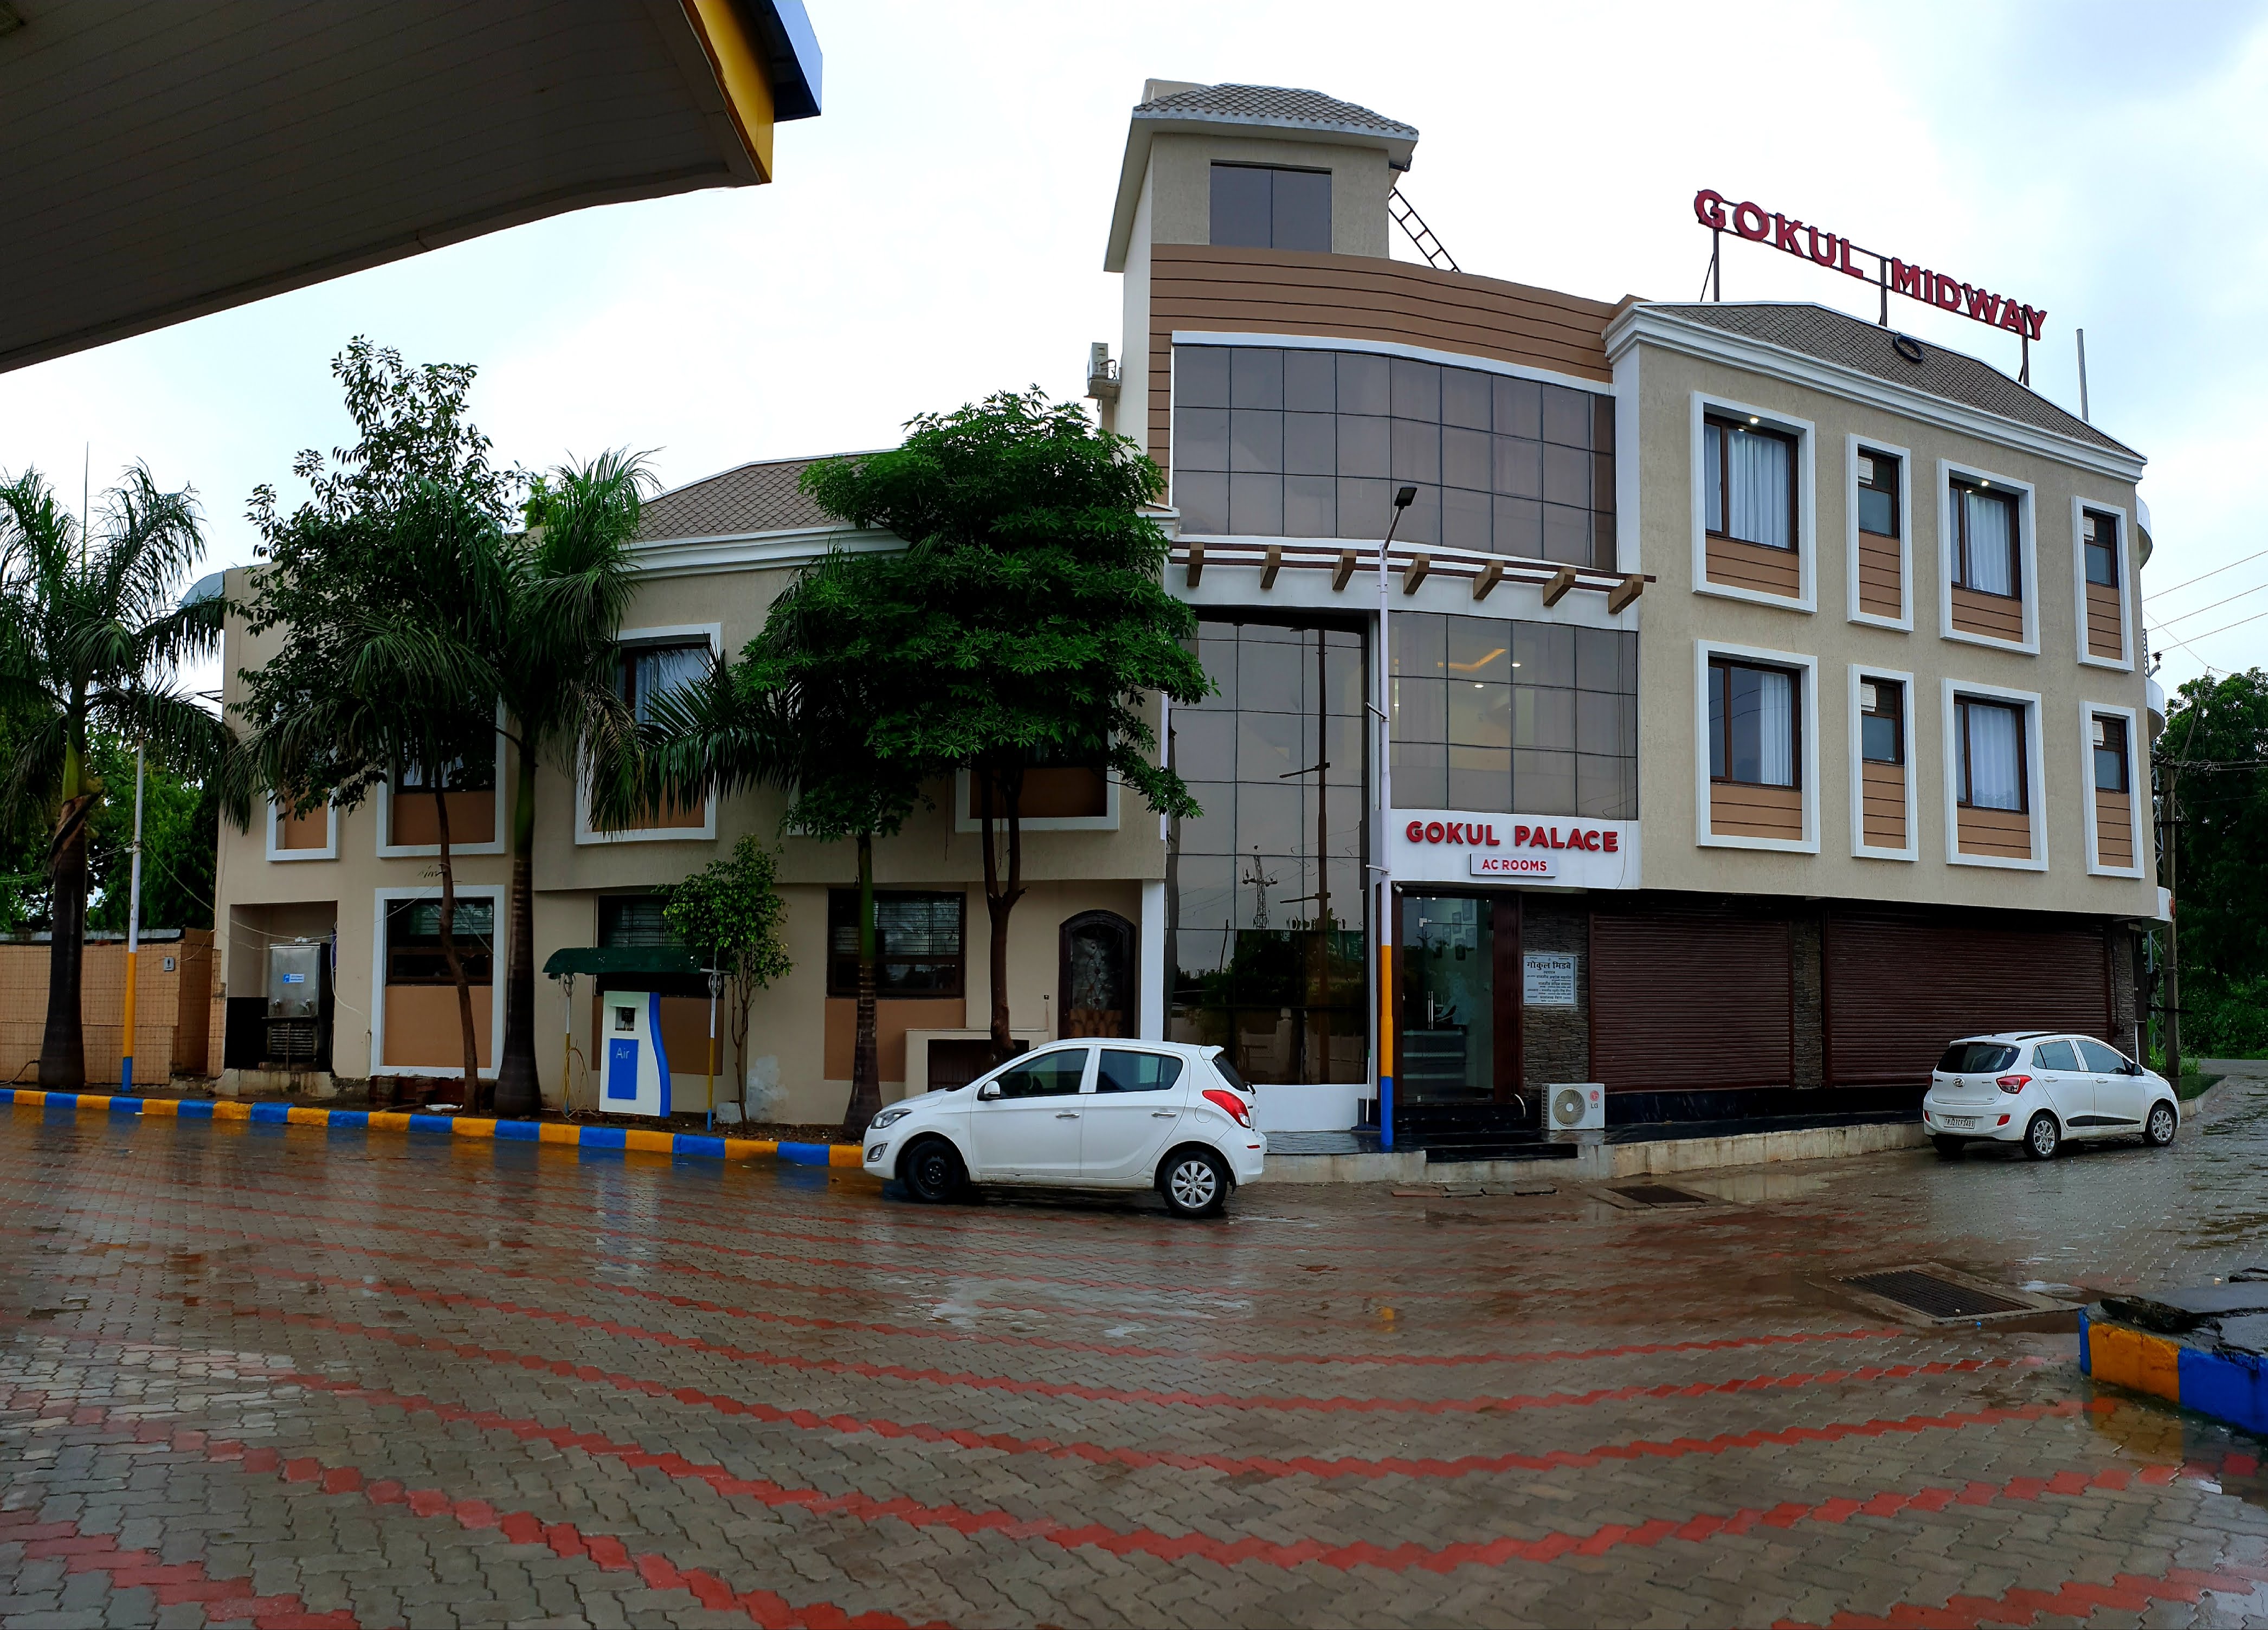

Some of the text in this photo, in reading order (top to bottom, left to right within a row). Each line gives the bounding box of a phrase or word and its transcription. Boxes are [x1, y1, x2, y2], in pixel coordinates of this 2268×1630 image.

[1694, 189, 2047, 342] GOKUL MIDWAY
[1406, 821, 1619, 852] GOKUL PALACE
[1482, 859, 1547, 872] AC ROOMS
[1527, 961, 1550, 970] गोकुल
[615, 1047, 629, 1059] Air
